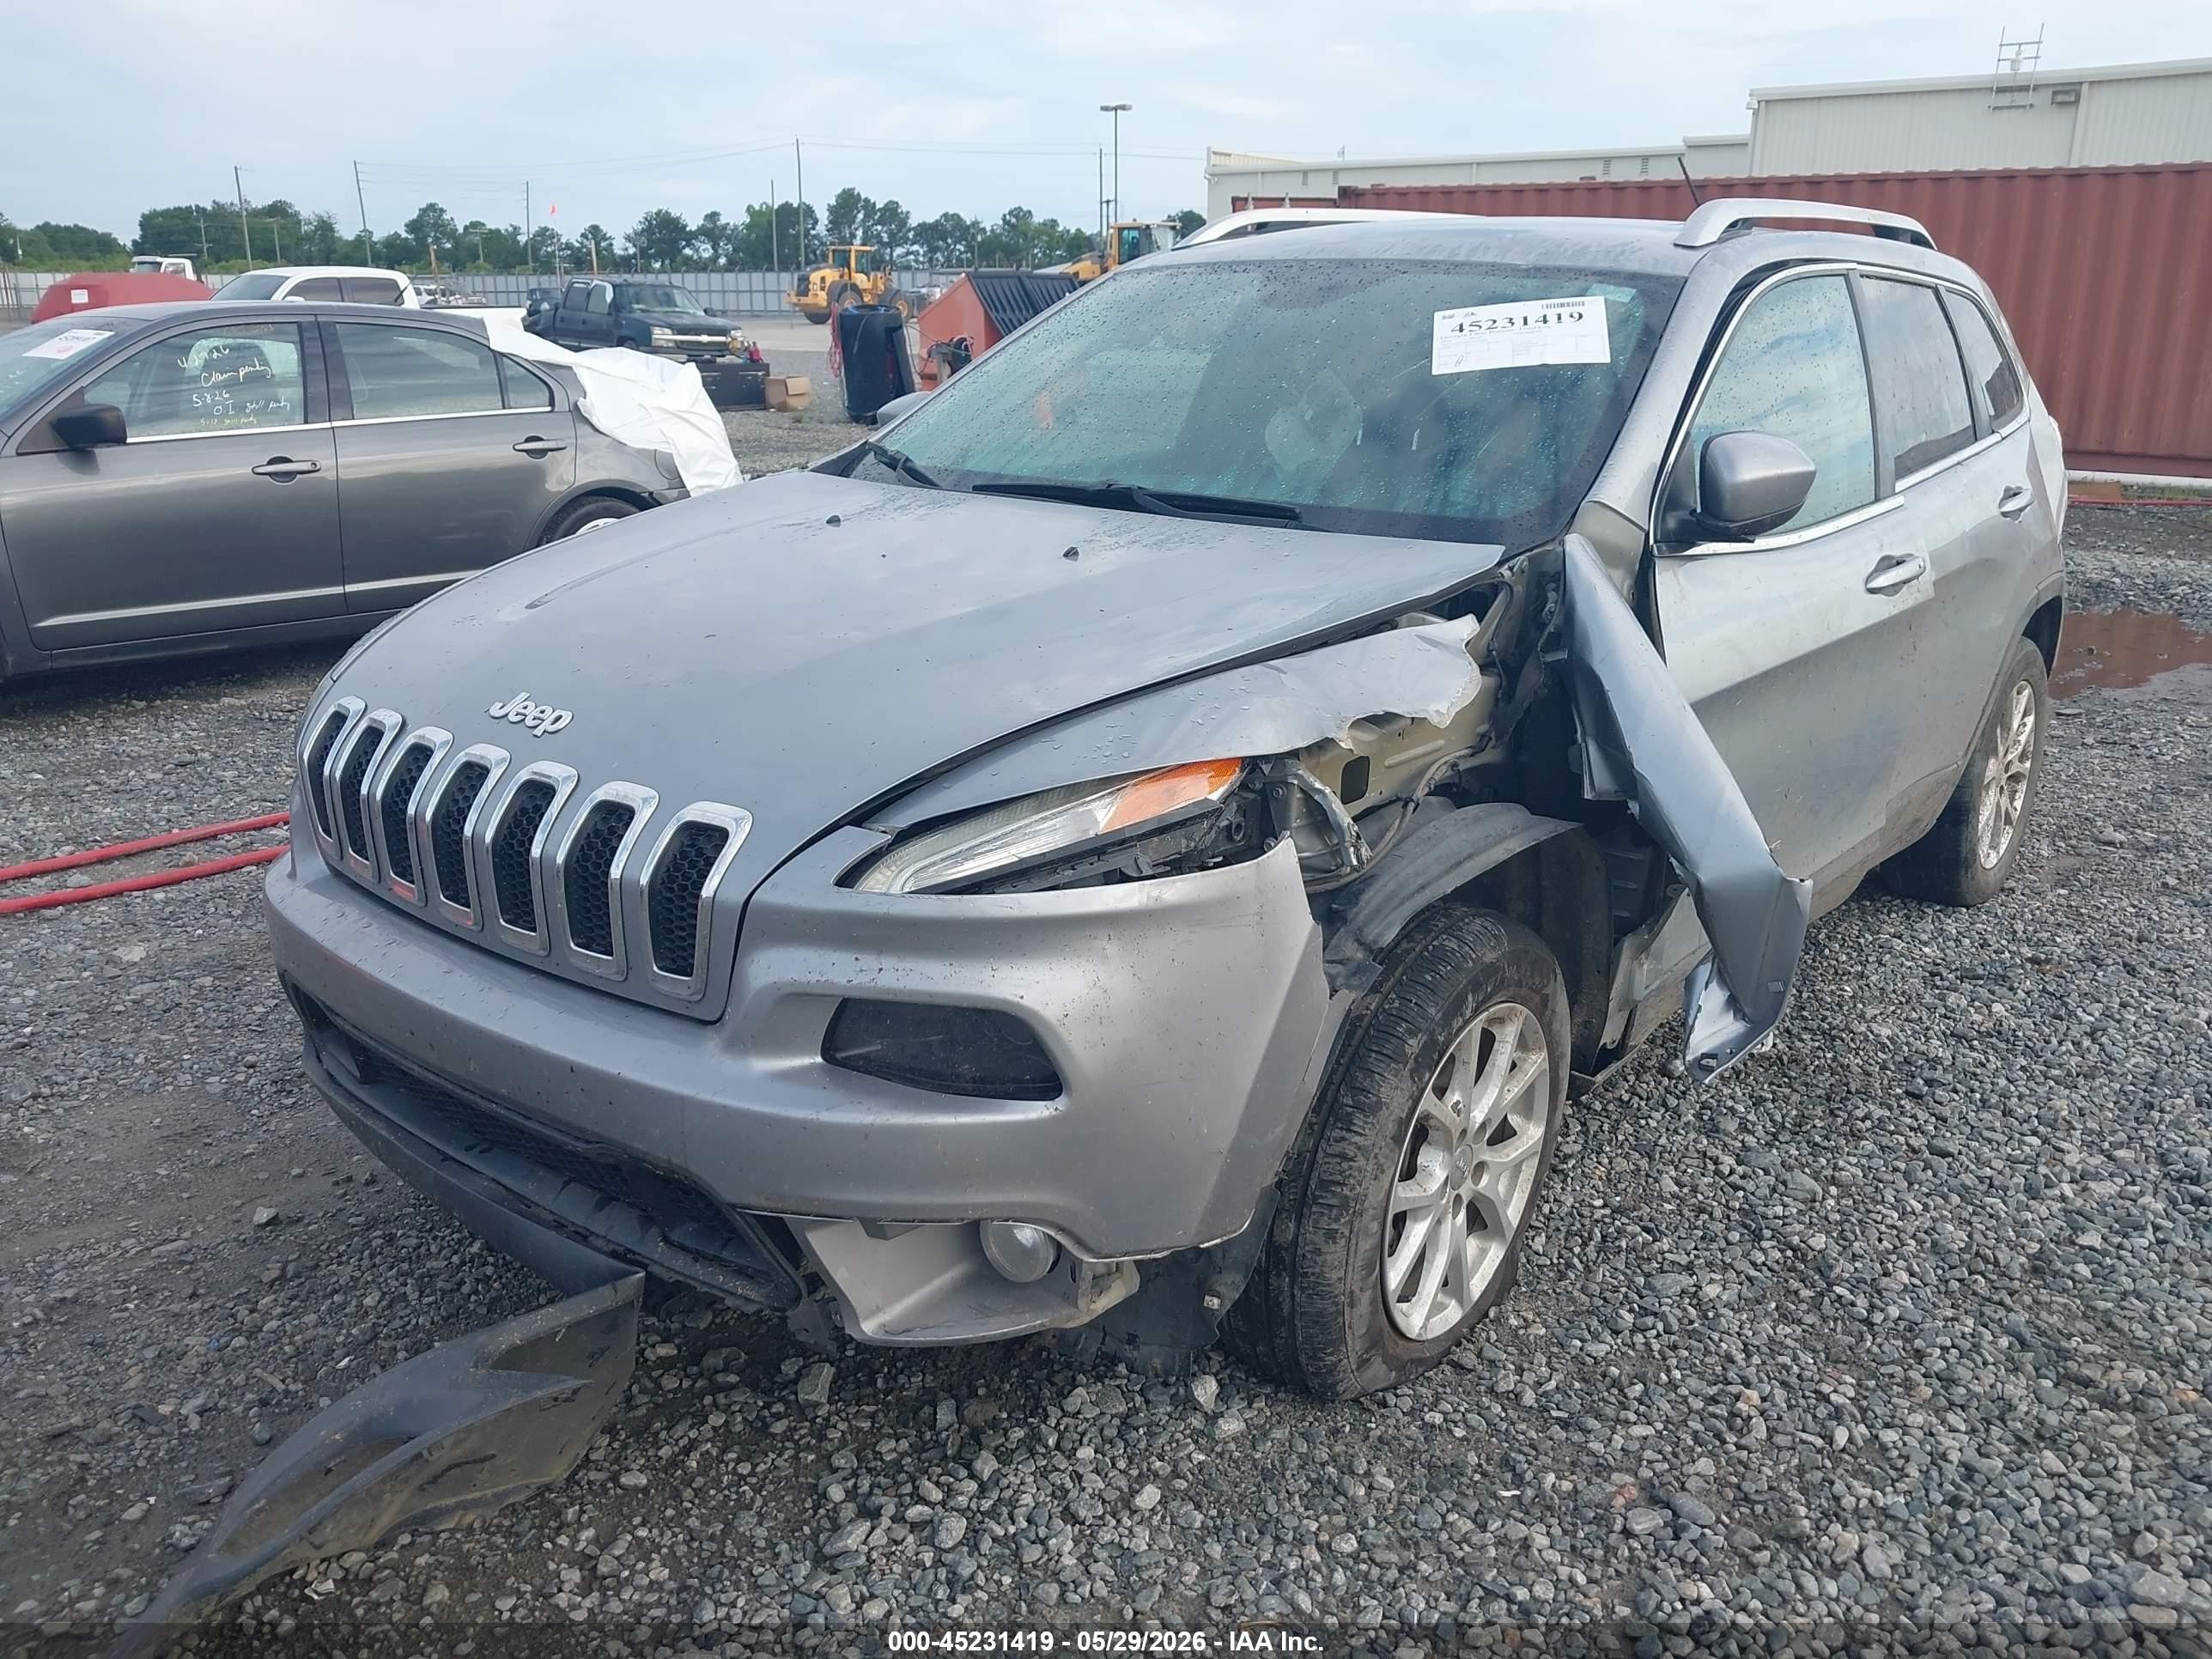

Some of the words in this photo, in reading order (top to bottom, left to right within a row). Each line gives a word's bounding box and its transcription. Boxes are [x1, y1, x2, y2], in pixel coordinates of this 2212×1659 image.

[1449, 311, 1584, 333] 45231419
[201, 368, 239, 388] Claim
[489, 691, 574, 738] Jeep
